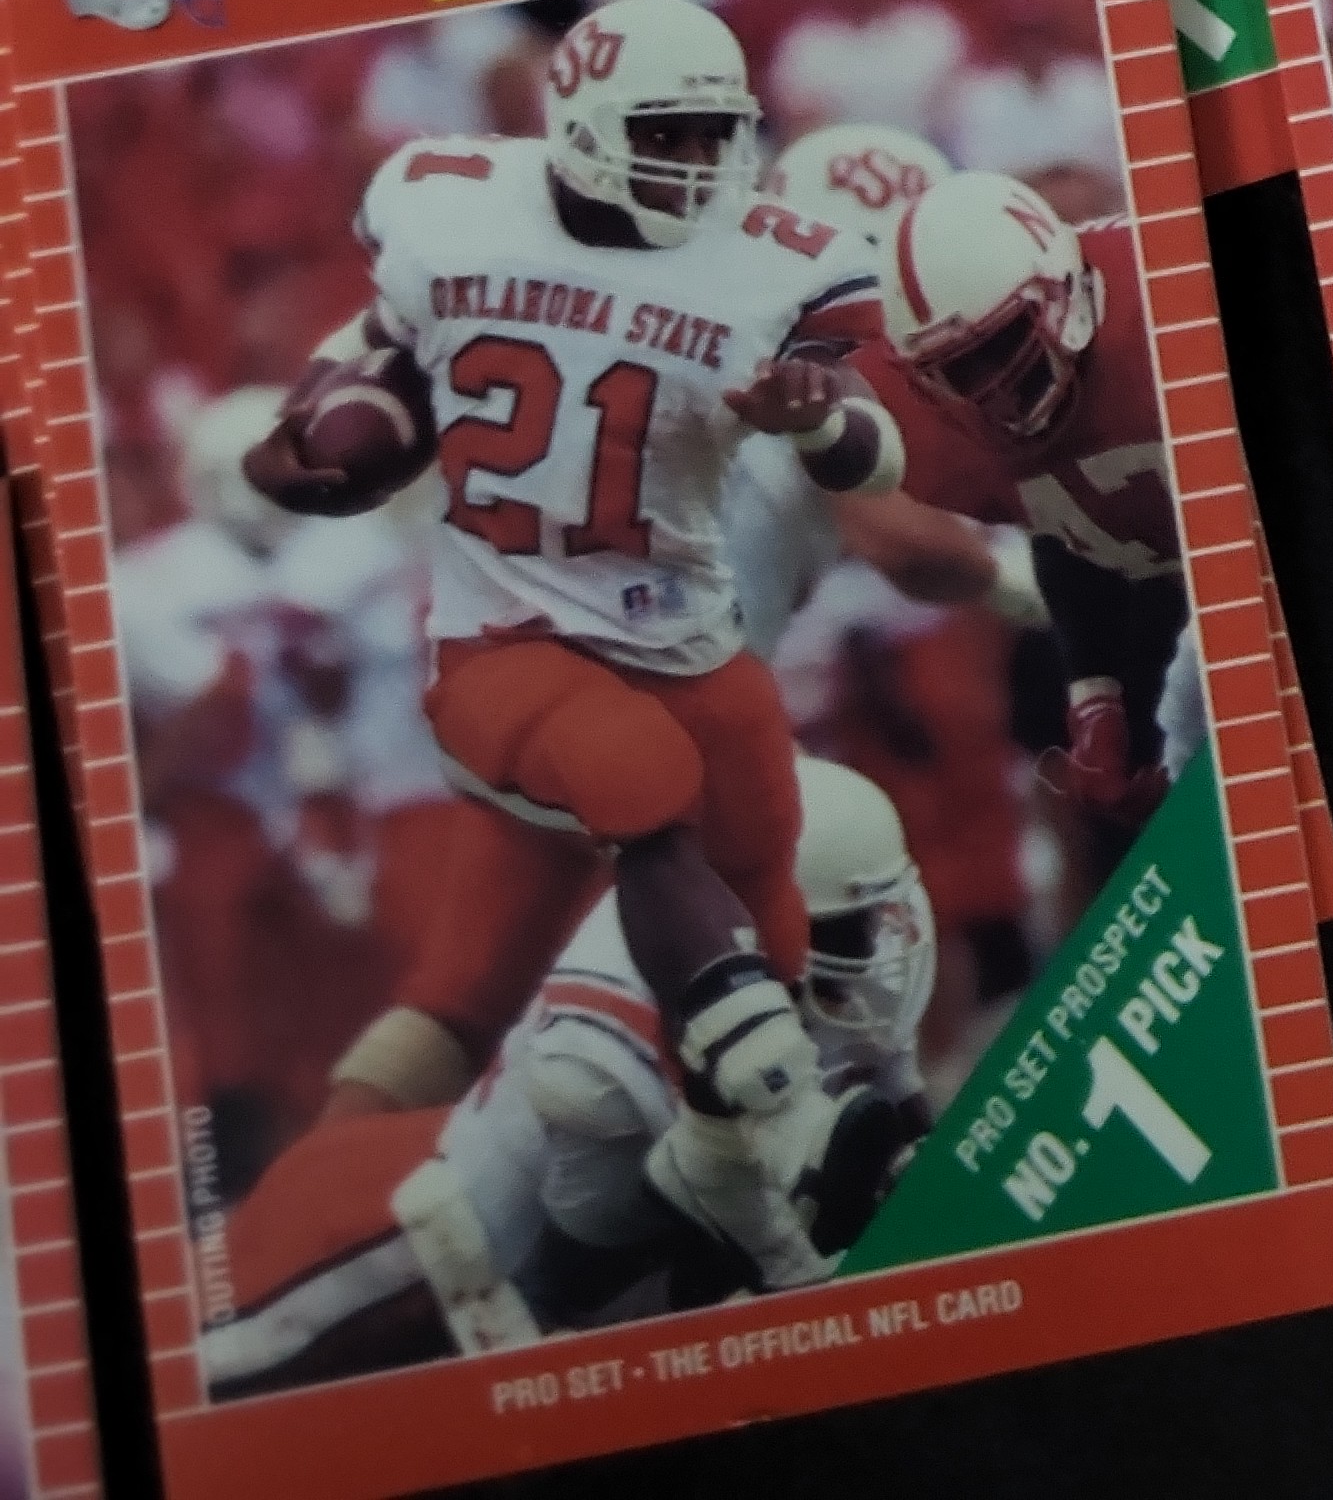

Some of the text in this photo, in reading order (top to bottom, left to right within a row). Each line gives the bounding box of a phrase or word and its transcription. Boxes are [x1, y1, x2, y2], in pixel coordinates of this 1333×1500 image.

[429, 274, 734, 371] OKLAHOMA STATE
[439, 332, 659, 558] 21
[955, 863, 1171, 1173] PRO SET PROSPECT
[1002, 915, 1225, 1221] NO. 1 PICK
[490, 1279, 1023, 1414] PRO SET THE OFFICIAL NFL CARD
